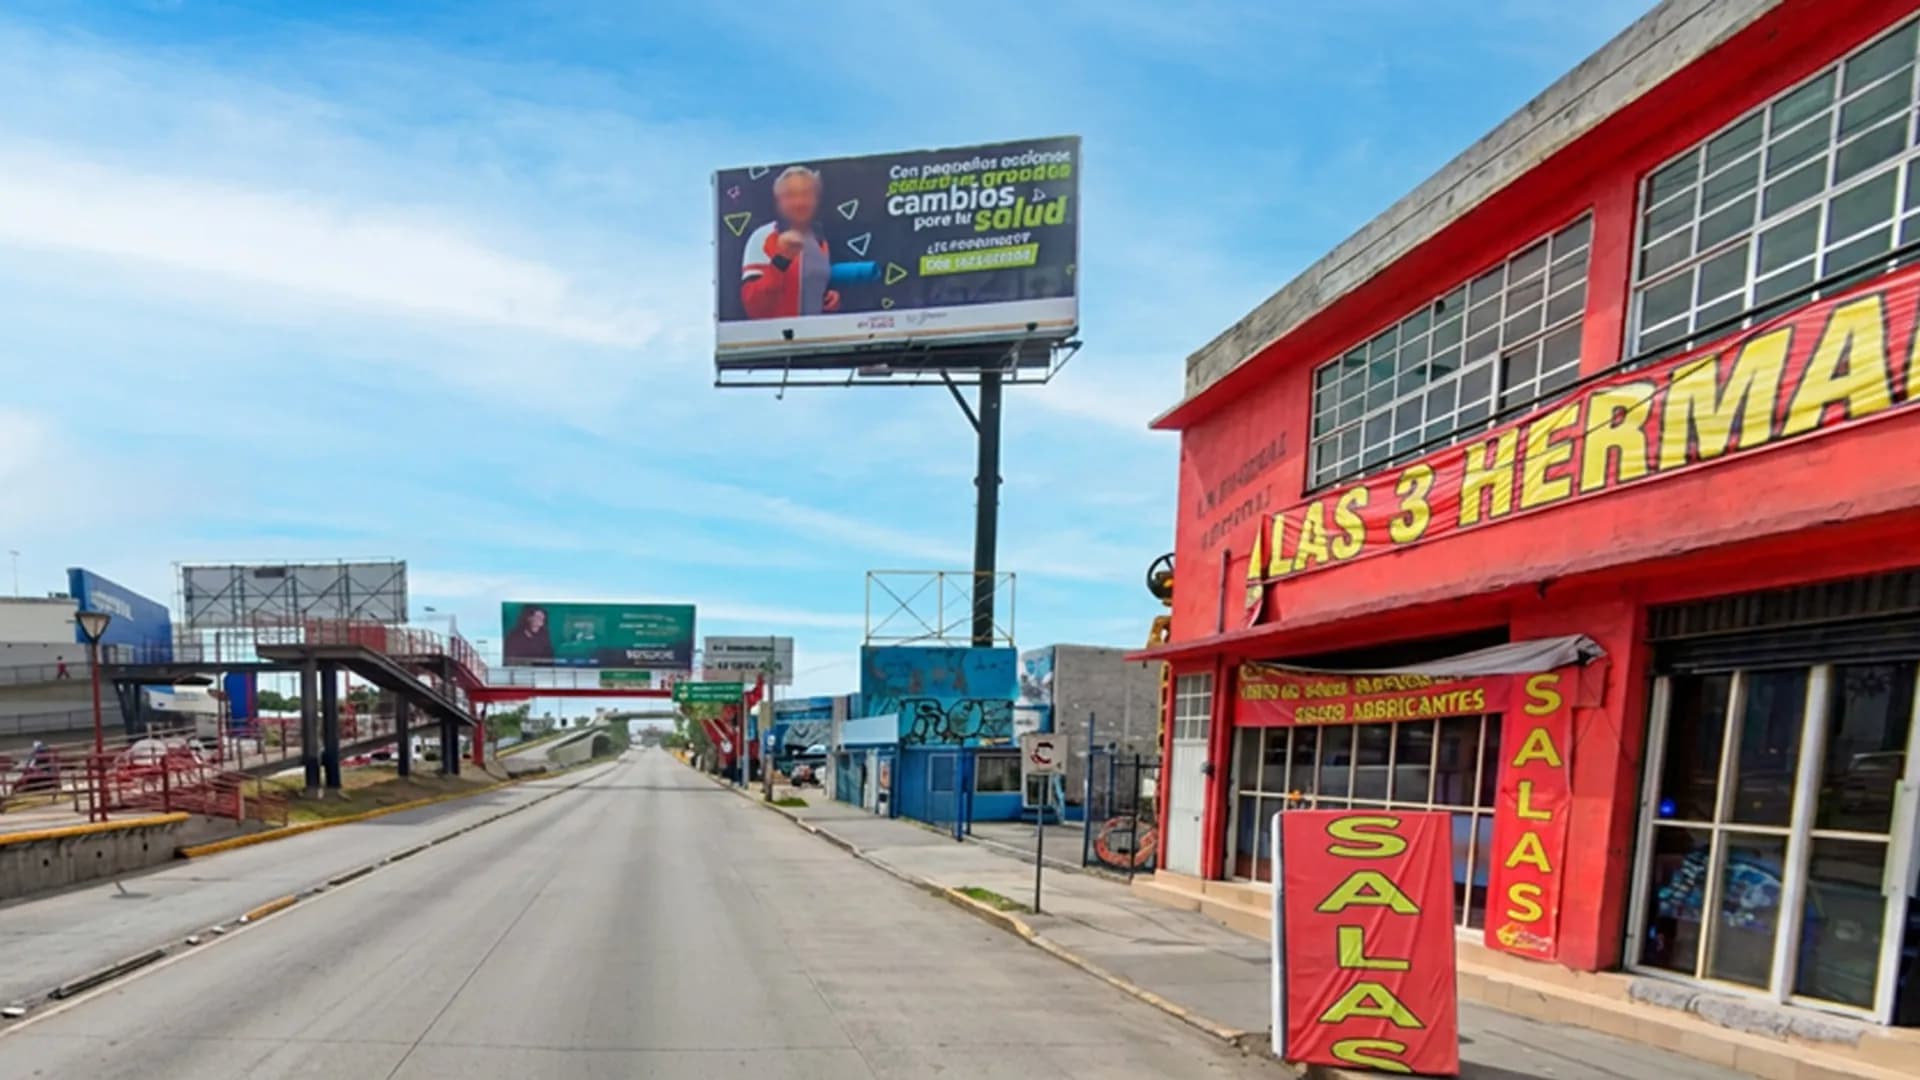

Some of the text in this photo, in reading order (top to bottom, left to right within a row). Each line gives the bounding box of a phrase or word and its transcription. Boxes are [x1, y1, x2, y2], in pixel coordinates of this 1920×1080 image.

[887, 181, 1016, 216] cambios
[974, 194, 1068, 232] salud
[1389, 463, 1436, 544] 3
[1458, 290, 1920, 529] HERMA
[1505, 672, 1563, 923] SALAS
